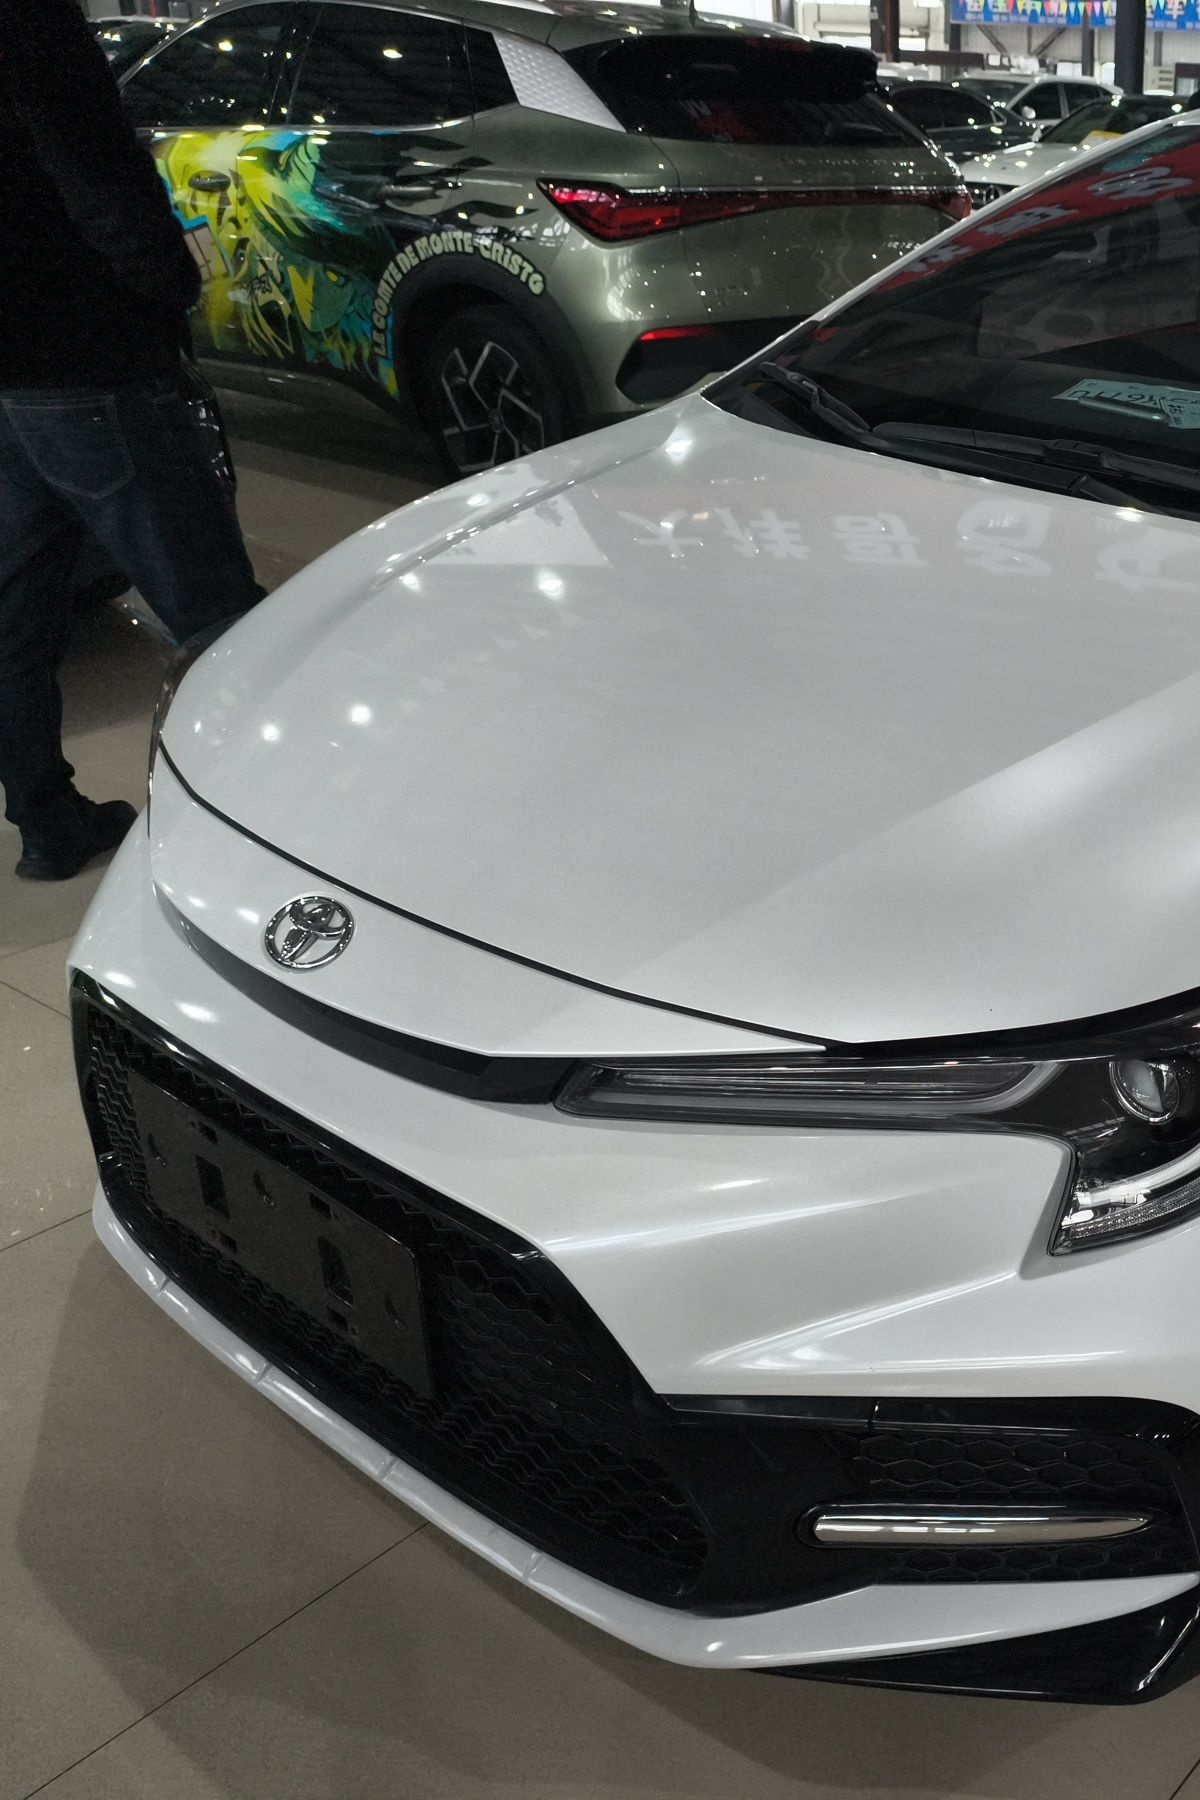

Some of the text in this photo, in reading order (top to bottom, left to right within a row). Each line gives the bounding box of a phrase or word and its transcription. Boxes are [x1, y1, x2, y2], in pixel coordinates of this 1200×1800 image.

[396, 245, 419, 275] DE
[372, 262, 403, 328] COMTE
[374, 330, 387, 357] LE
